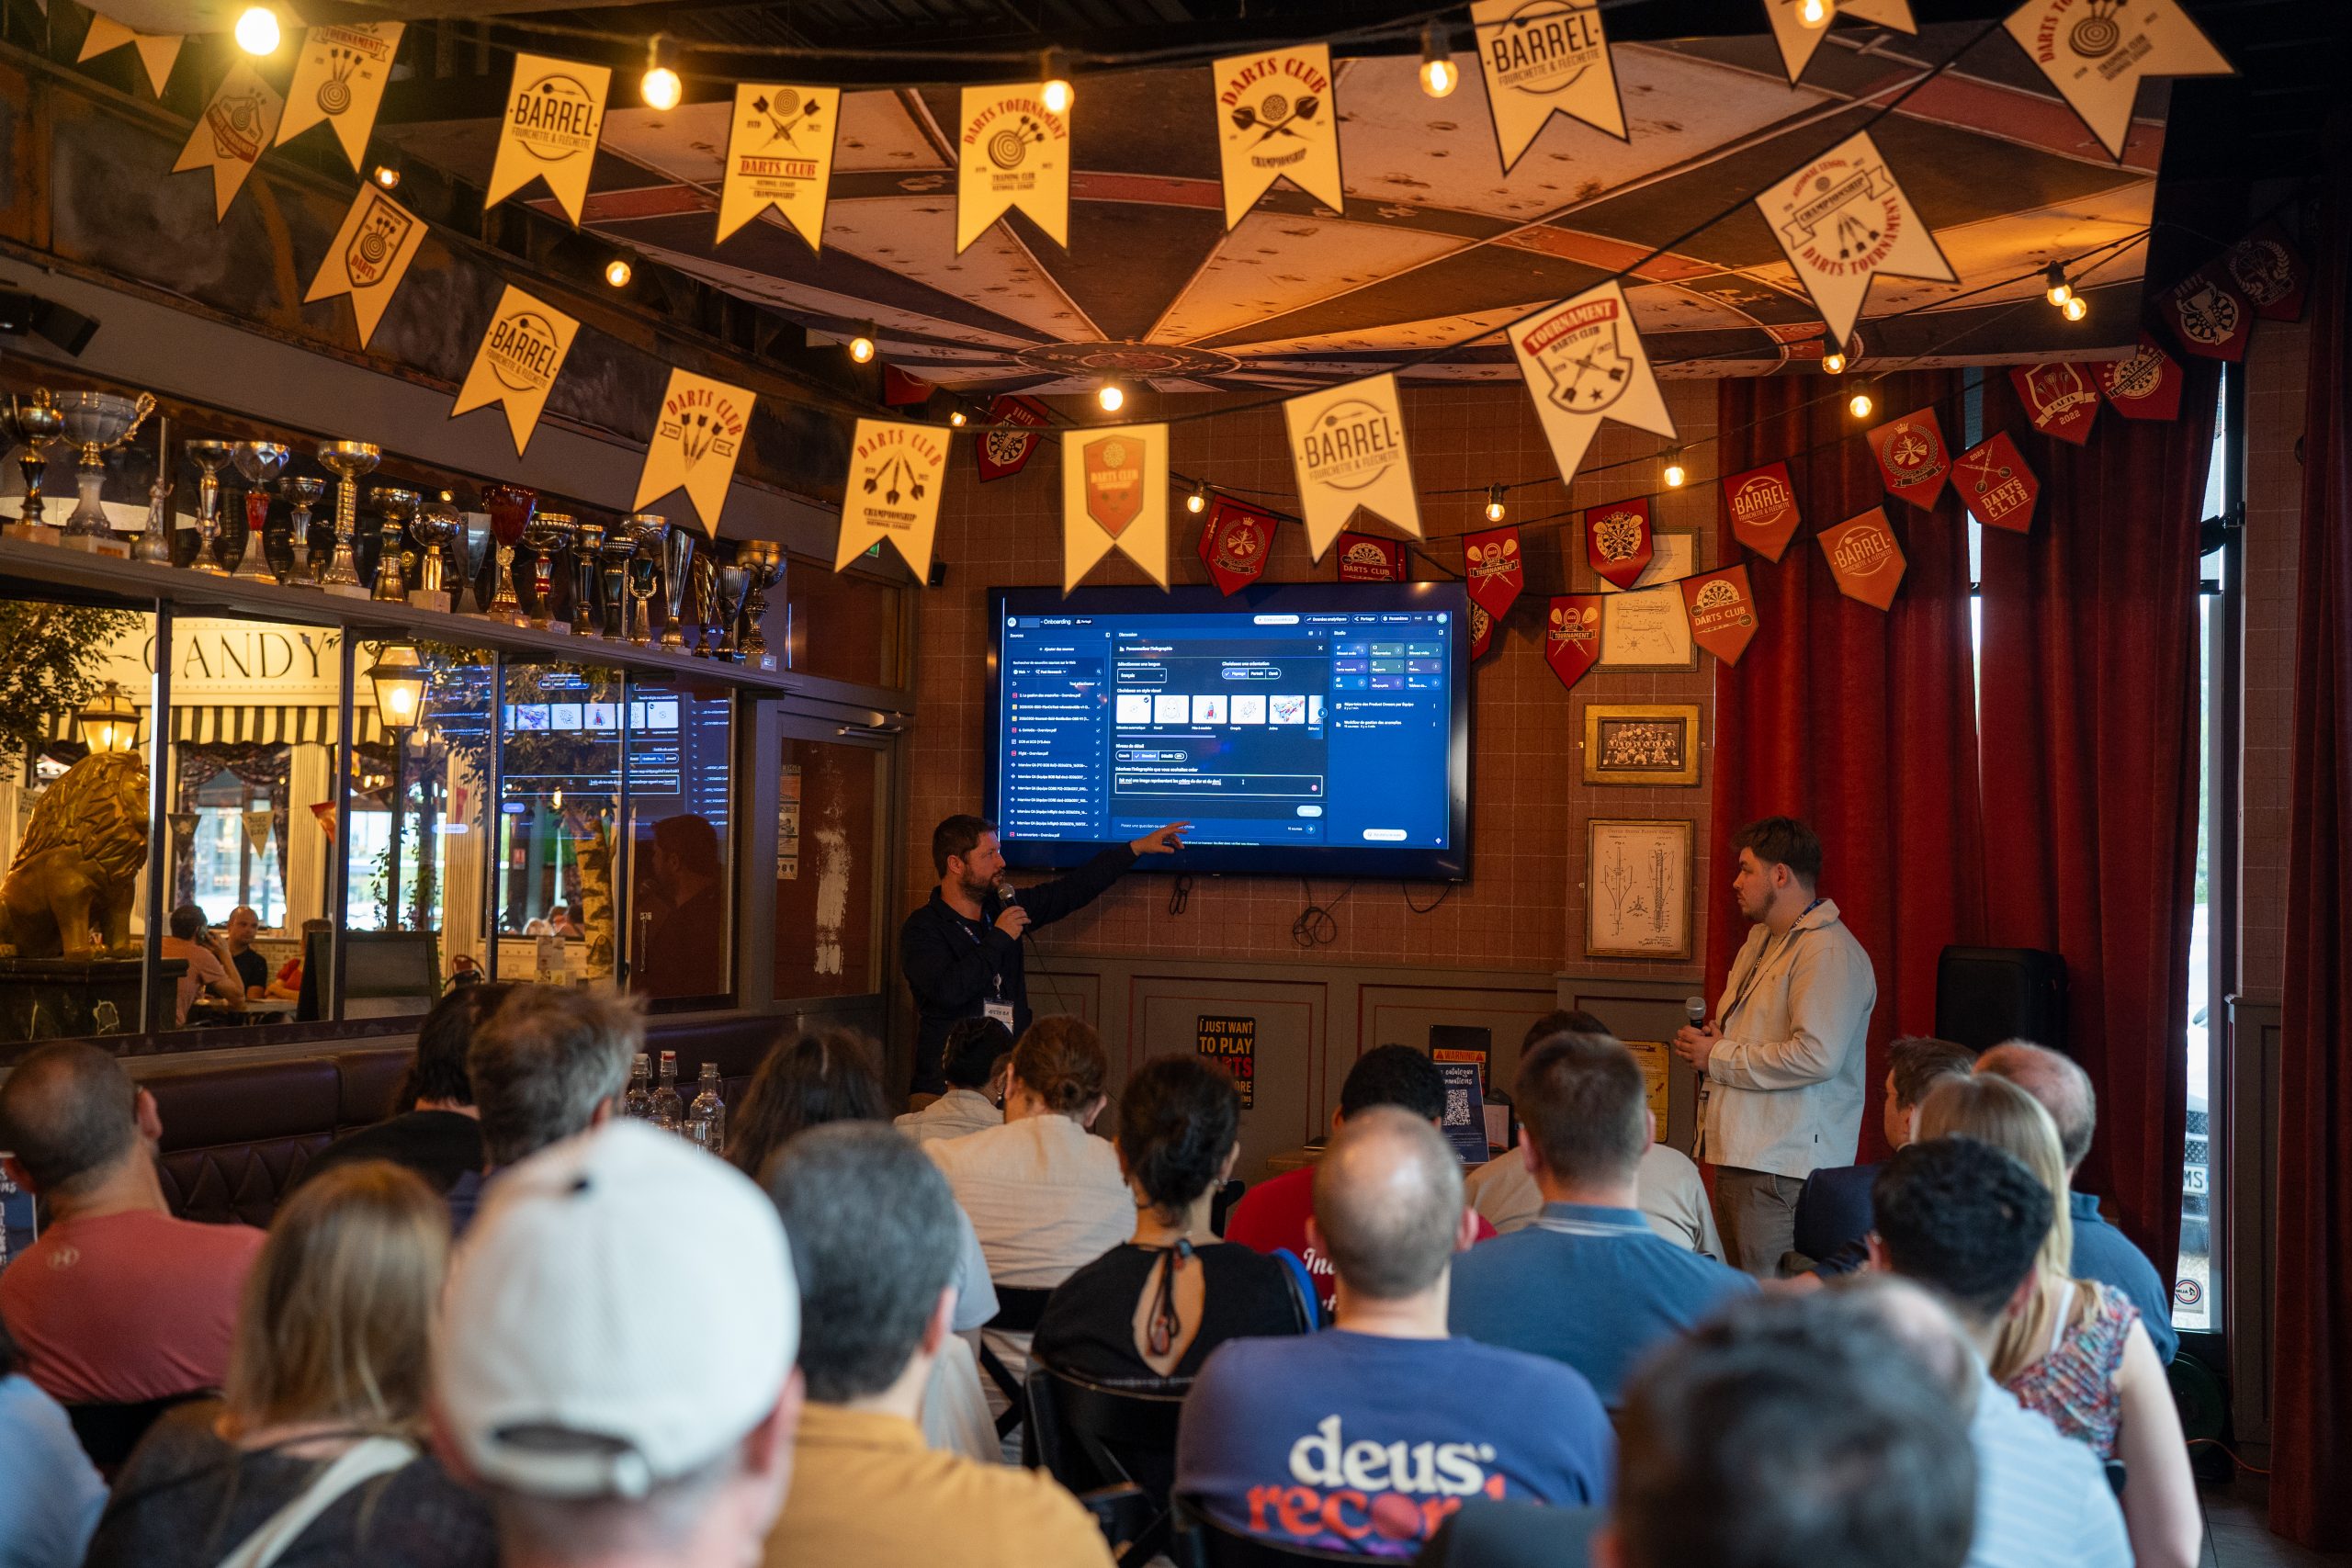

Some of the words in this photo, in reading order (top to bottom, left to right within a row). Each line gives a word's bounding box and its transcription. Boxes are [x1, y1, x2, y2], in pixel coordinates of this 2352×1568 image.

[1492, 14, 1597, 73] BARREL
[2037, 16, 2059, 63] DARTS
[1221, 57, 1277, 107] DARTS
[1284, 57, 1328, 94] CLUB
[1498, 66, 1547, 86] FOURCHETTE
[515, 94, 593, 137] BARREL
[964, 107, 995, 145] DARTS
[998, 98, 1066, 140] TOURNAMENT
[1251, 148, 1306, 168] CHAMPIONSHIP
[741, 160, 781, 175] DARTS
[786, 162, 816, 177] CLUB
[1800, 177, 1865, 222] CHAMPIONSHIP
[1802, 246, 1845, 276] DARTS
[1850, 197, 1901, 275] TOURNAMENT
[351, 254, 376, 280] DARTS
[1528, 302, 1613, 350] TOURNAMENT
[491, 321, 556, 378] BARREL
[1551, 334, 1579, 353] DARTS
[1579, 326, 1600, 341] CLUB
[667, 389, 713, 416] DARTS
[716, 399, 742, 435] CLUB
[2050, 395, 2075, 411] DARTS
[1013, 406, 1035, 426] DARTS
[2059, 410, 2081, 425] 2022
[857, 429, 904, 459] DARTS
[911, 434, 943, 467] CLUB
[1304, 417, 1397, 469] BARREL
[1969, 449, 1985, 462] 2022
[1090, 471, 1117, 484] DARTS
[1118, 469, 1139, 480] CLUB
[1911, 473, 1928, 484] Darts
[1734, 484, 1789, 515] BARREL
[1981, 479, 2023, 509] DARTS
[1989, 490, 2028, 518] CLUB
[864, 507, 917, 523] CHAMPIONSHIP
[1739, 510, 1764, 522] FOURCHETTE
[1834, 531, 1891, 569] BARREL
[1343, 565, 1368, 573] DARTS
[1371, 568, 1390, 576] CLUB
[1476, 564, 1513, 575] TOURNAMENT
[1842, 561, 1867, 575] FOURCHETTE
[1695, 612, 1722, 626] DARTS
[1724, 606, 1746, 618] CLUB
[1199, 1021, 1203, 1032] I
[1204, 1021, 1227, 1033] JUST
[1228, 1022, 1254, 1034] WANT
[1199, 1037, 1216, 1053] TO
[1220, 1037, 1253, 1054] PLAY
[1445, 1051, 1475, 1061] WARNING
[1446, 1067, 1473, 1078] catalogue
